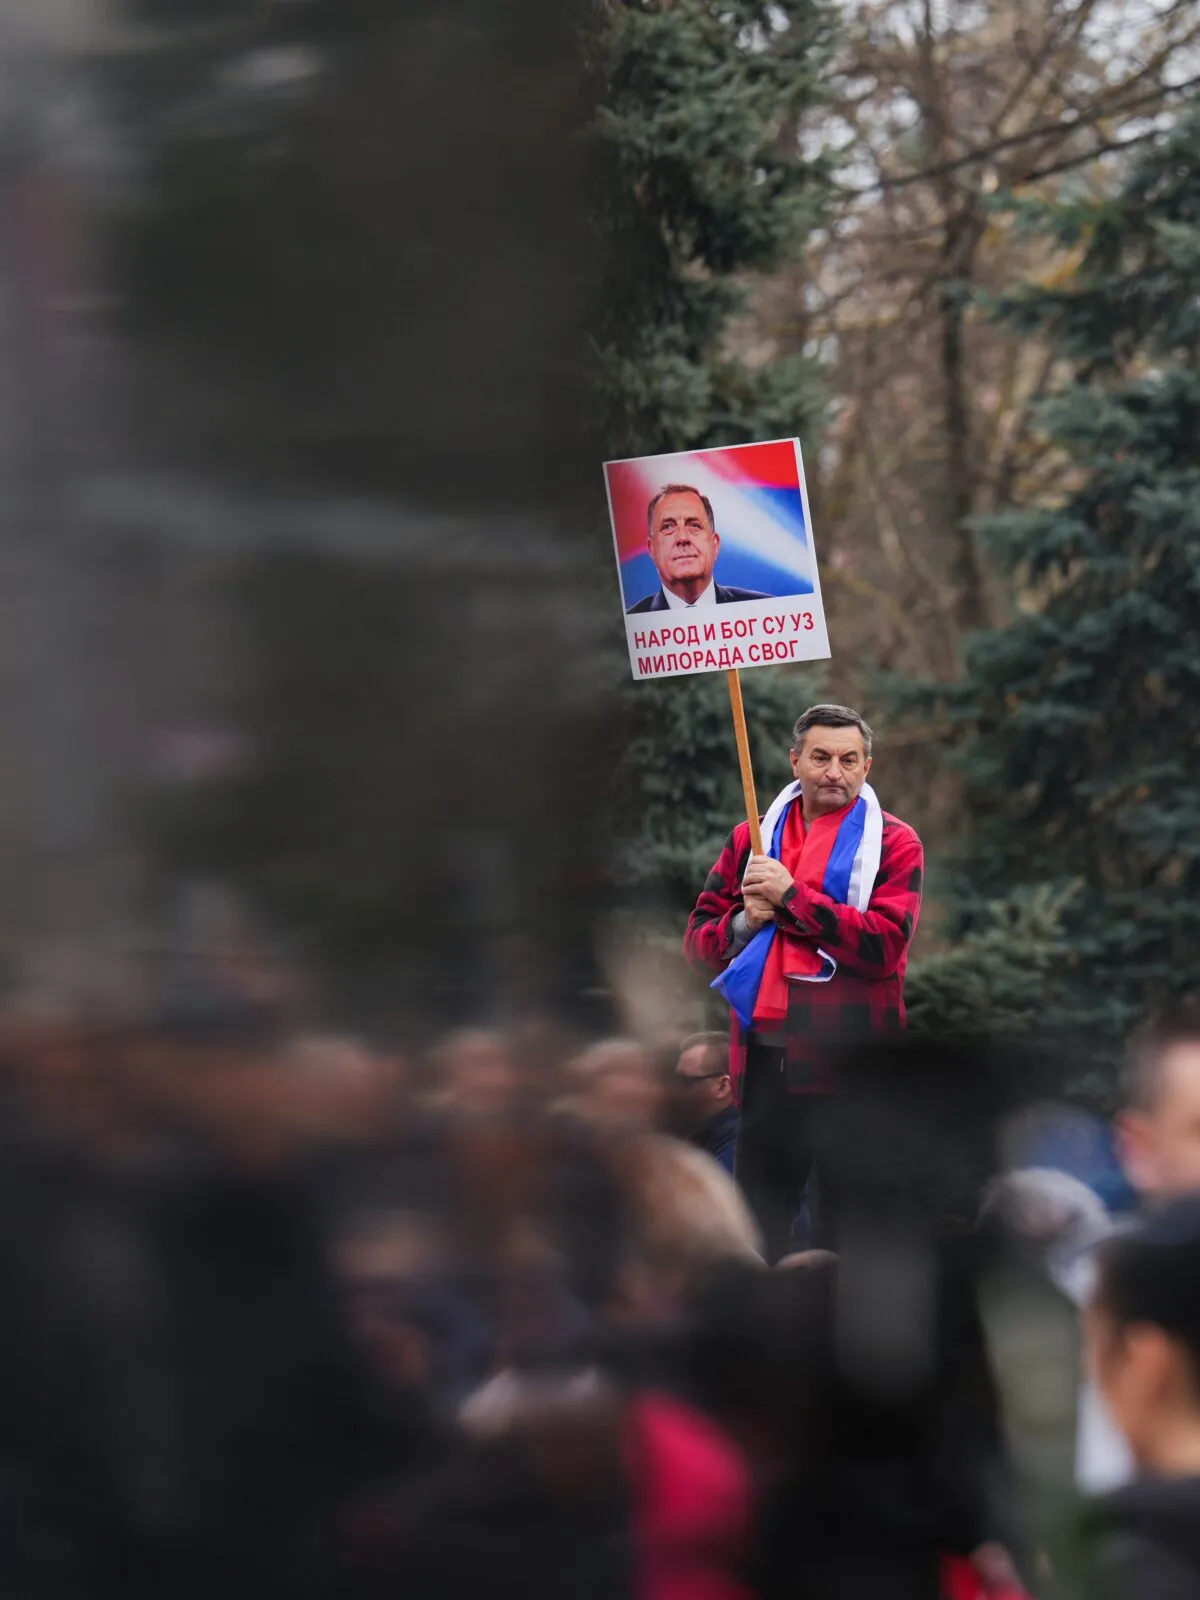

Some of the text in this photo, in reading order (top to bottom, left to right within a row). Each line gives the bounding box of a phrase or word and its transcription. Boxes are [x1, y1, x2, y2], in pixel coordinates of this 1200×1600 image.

[634, 612, 814, 649] НАРОД И БОГ СУ УЗ
[638, 639, 799, 674] МИЛОРАДА СВОГ
